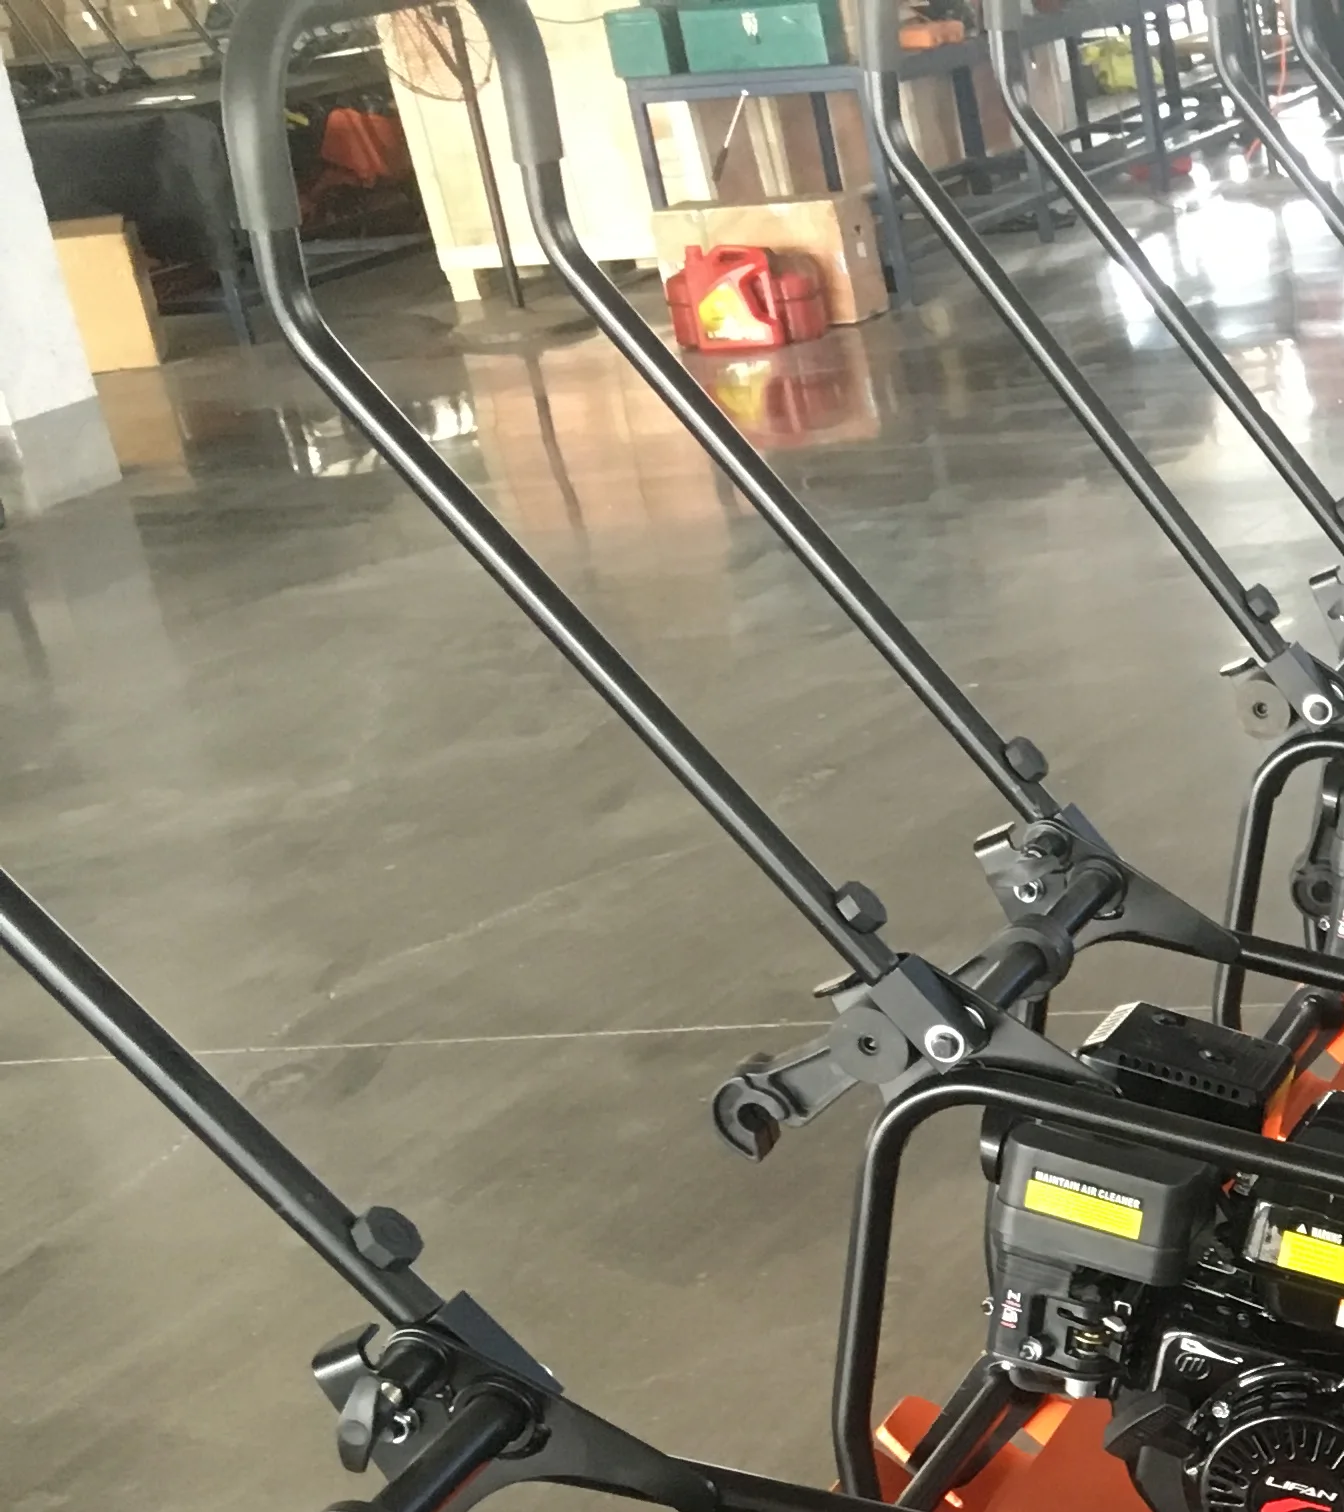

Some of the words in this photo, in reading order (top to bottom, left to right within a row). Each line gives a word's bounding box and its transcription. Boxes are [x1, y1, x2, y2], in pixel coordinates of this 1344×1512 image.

[1035, 1170, 1081, 1192] MAINTAIN
[1080, 1184, 1098, 1197] AIR
[1097, 1189, 1140, 1209] CLEANER
[1265, 1476, 1339, 1502] LIFAN
